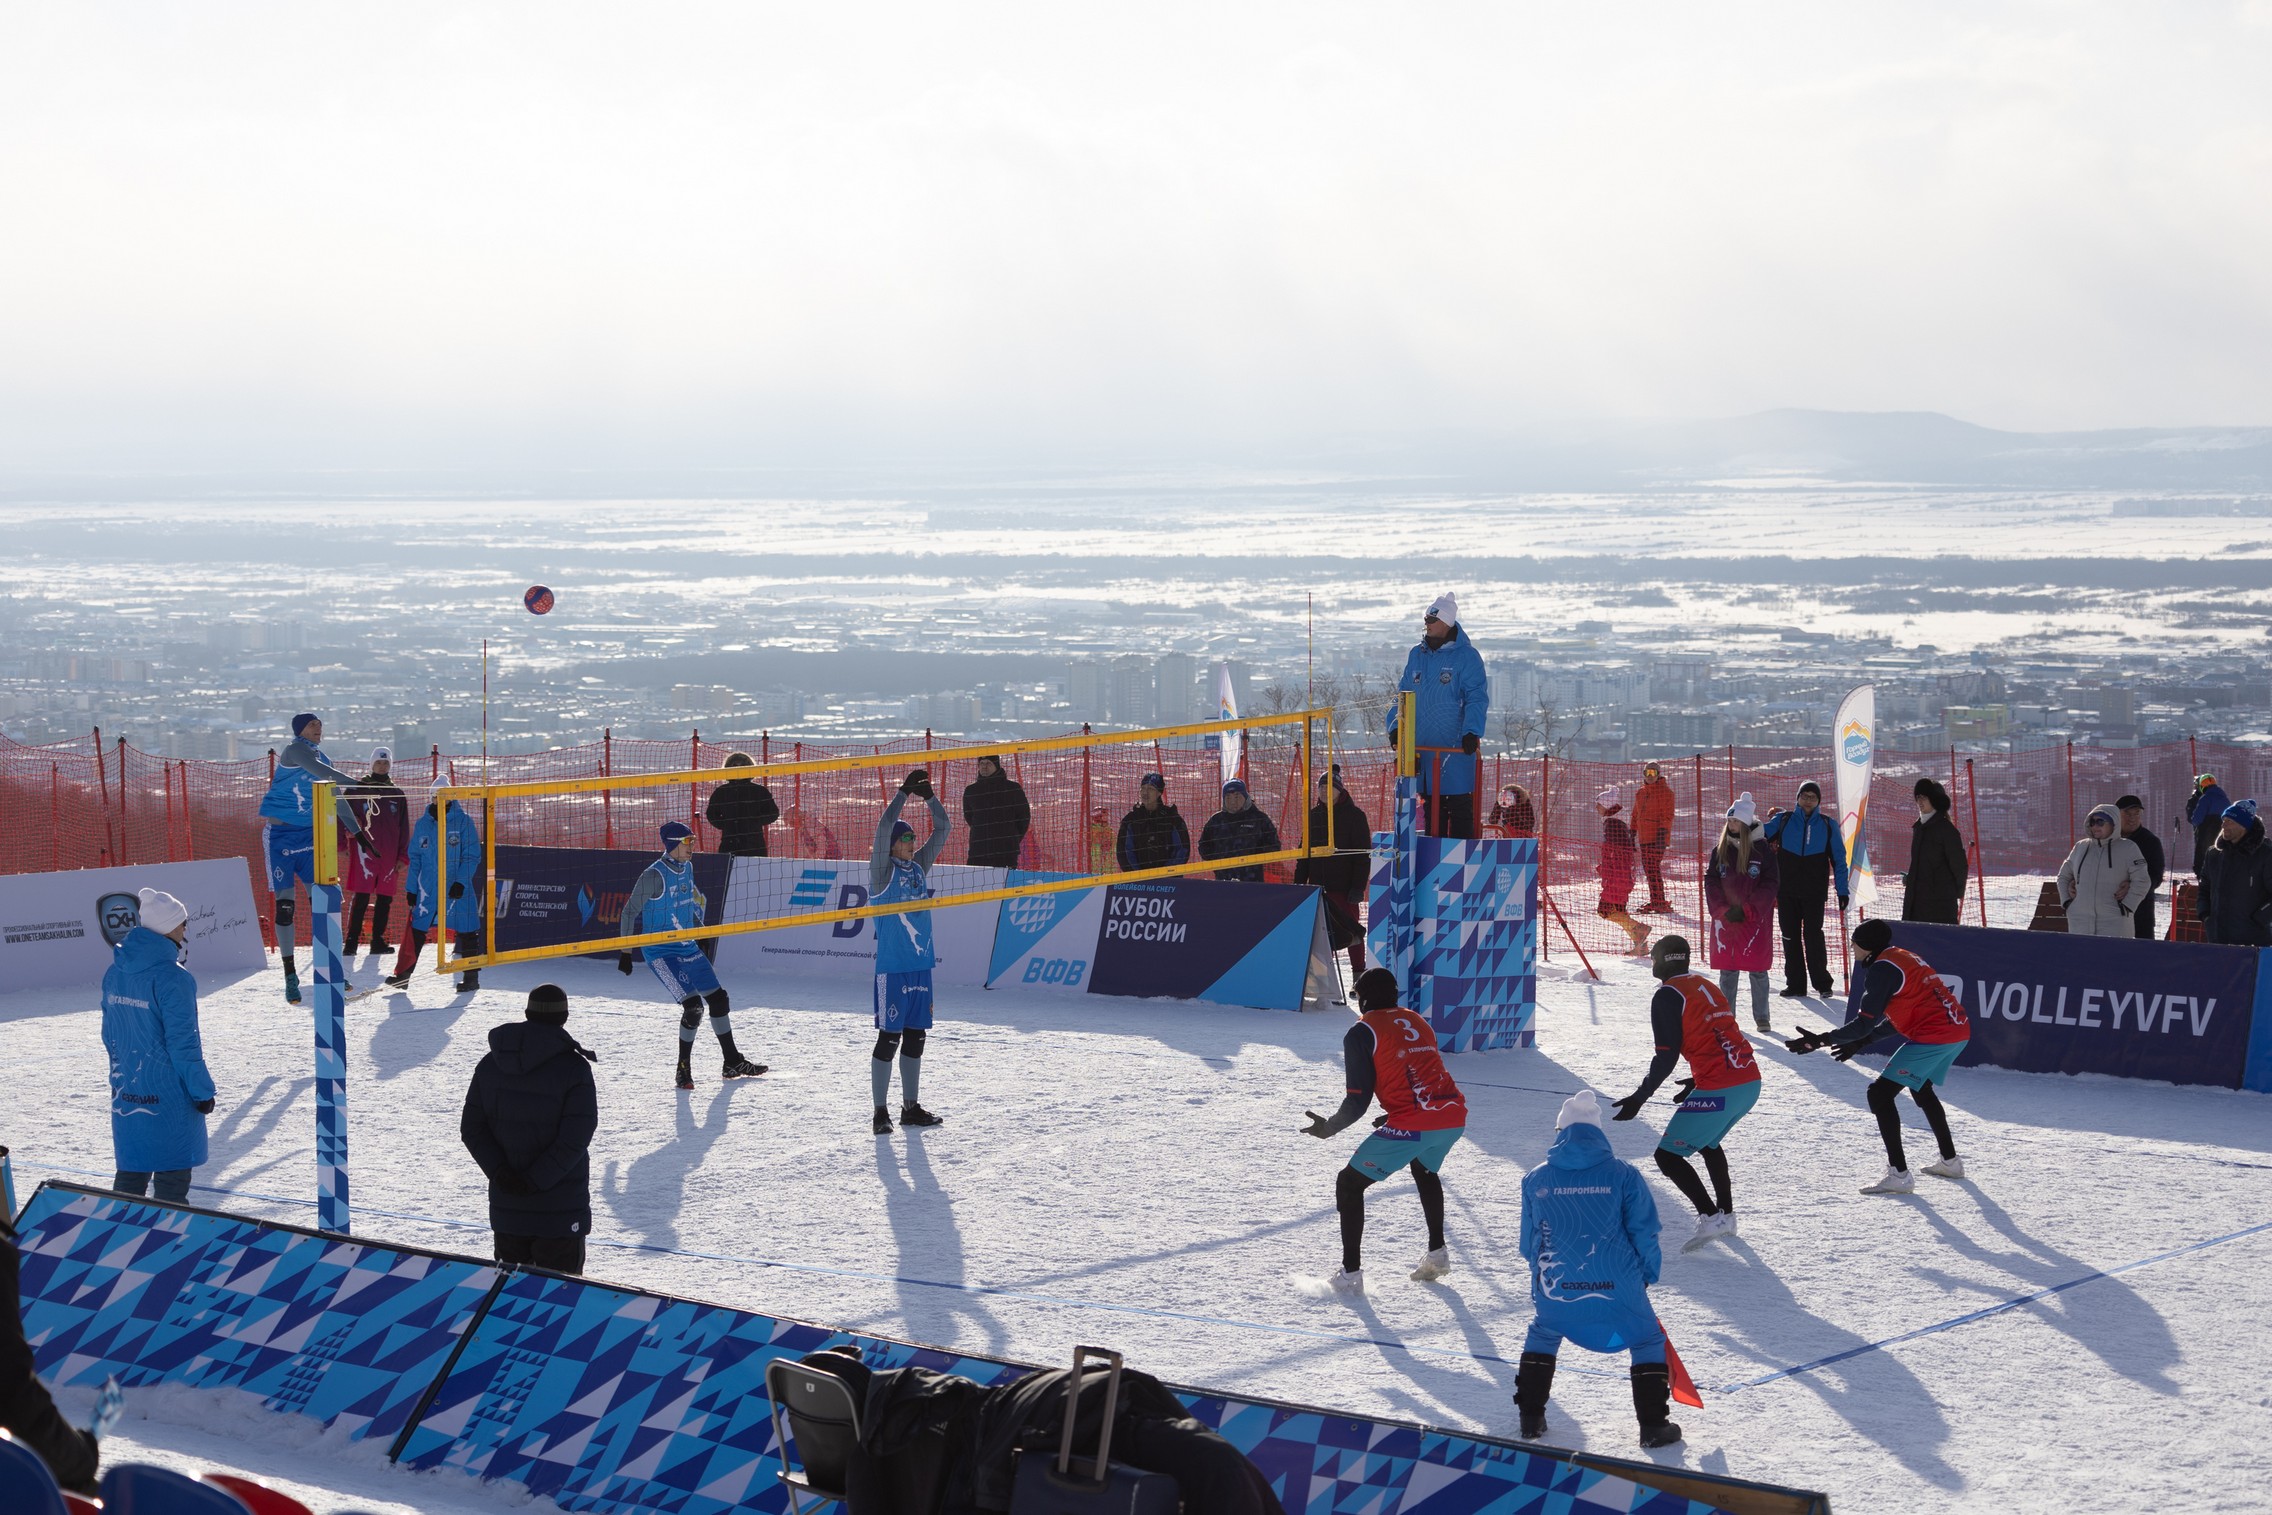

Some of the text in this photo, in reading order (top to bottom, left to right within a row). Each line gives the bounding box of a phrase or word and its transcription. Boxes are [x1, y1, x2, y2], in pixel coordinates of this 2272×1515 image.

[516, 883, 566, 893] МИНИСТЕРСТВО
[1113, 882, 1176, 893] ВОЛЕЙБОЛ НА СНЕГУ
[515, 892, 539, 900] СПОРТА
[521, 901, 567, 911] САХАЛИНСКОЙ
[1109, 896, 1175, 919] КУБОК
[1505, 904, 1522, 916] ВФВ
[519, 910, 548, 918] ОБЛАСТИ
[5, 928, 85, 944] WWW.ONETEAMSAKHALIN.COM
[1105, 919, 1187, 943] РОССИИ
[762, 946, 801, 955] Генеральный
[802, 949, 825, 957] спонсор
[826, 949, 872, 959] Всероссийской
[1022, 957, 1087, 986] ВФВ
[1697, 984, 1718, 1007] 1
[1977, 980, 2217, 1037] VOLLEYVFV
[1393, 1018, 1420, 1042] 3
[1553, 1186, 1612, 1196] ГАЗПРОМБАНК
